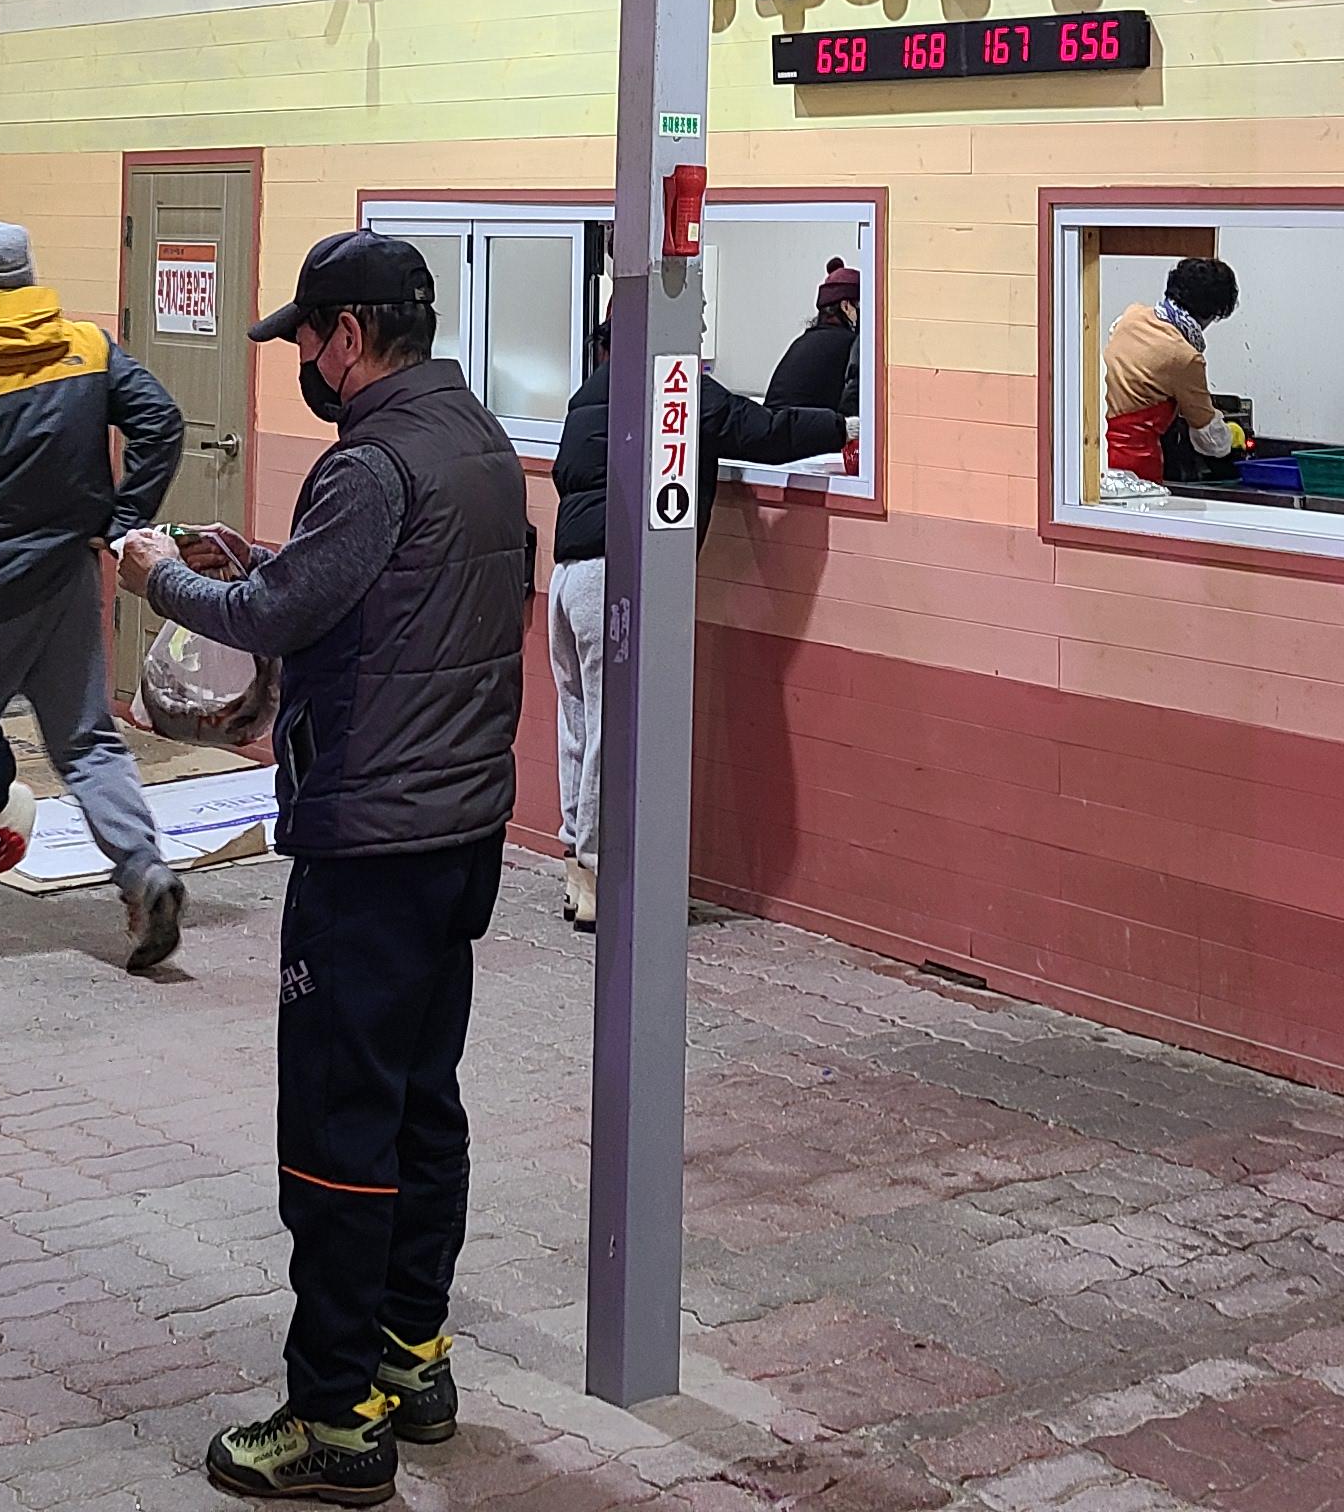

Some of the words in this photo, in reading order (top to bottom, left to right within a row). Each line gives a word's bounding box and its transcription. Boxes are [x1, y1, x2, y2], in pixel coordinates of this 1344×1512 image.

[816, 37, 868, 74] 658
[904, 31, 947, 71] 168
[983, 25, 1031, 65] 167
[1059, 20, 1121, 63] 656
[661, 360, 689, 478] 소화기
